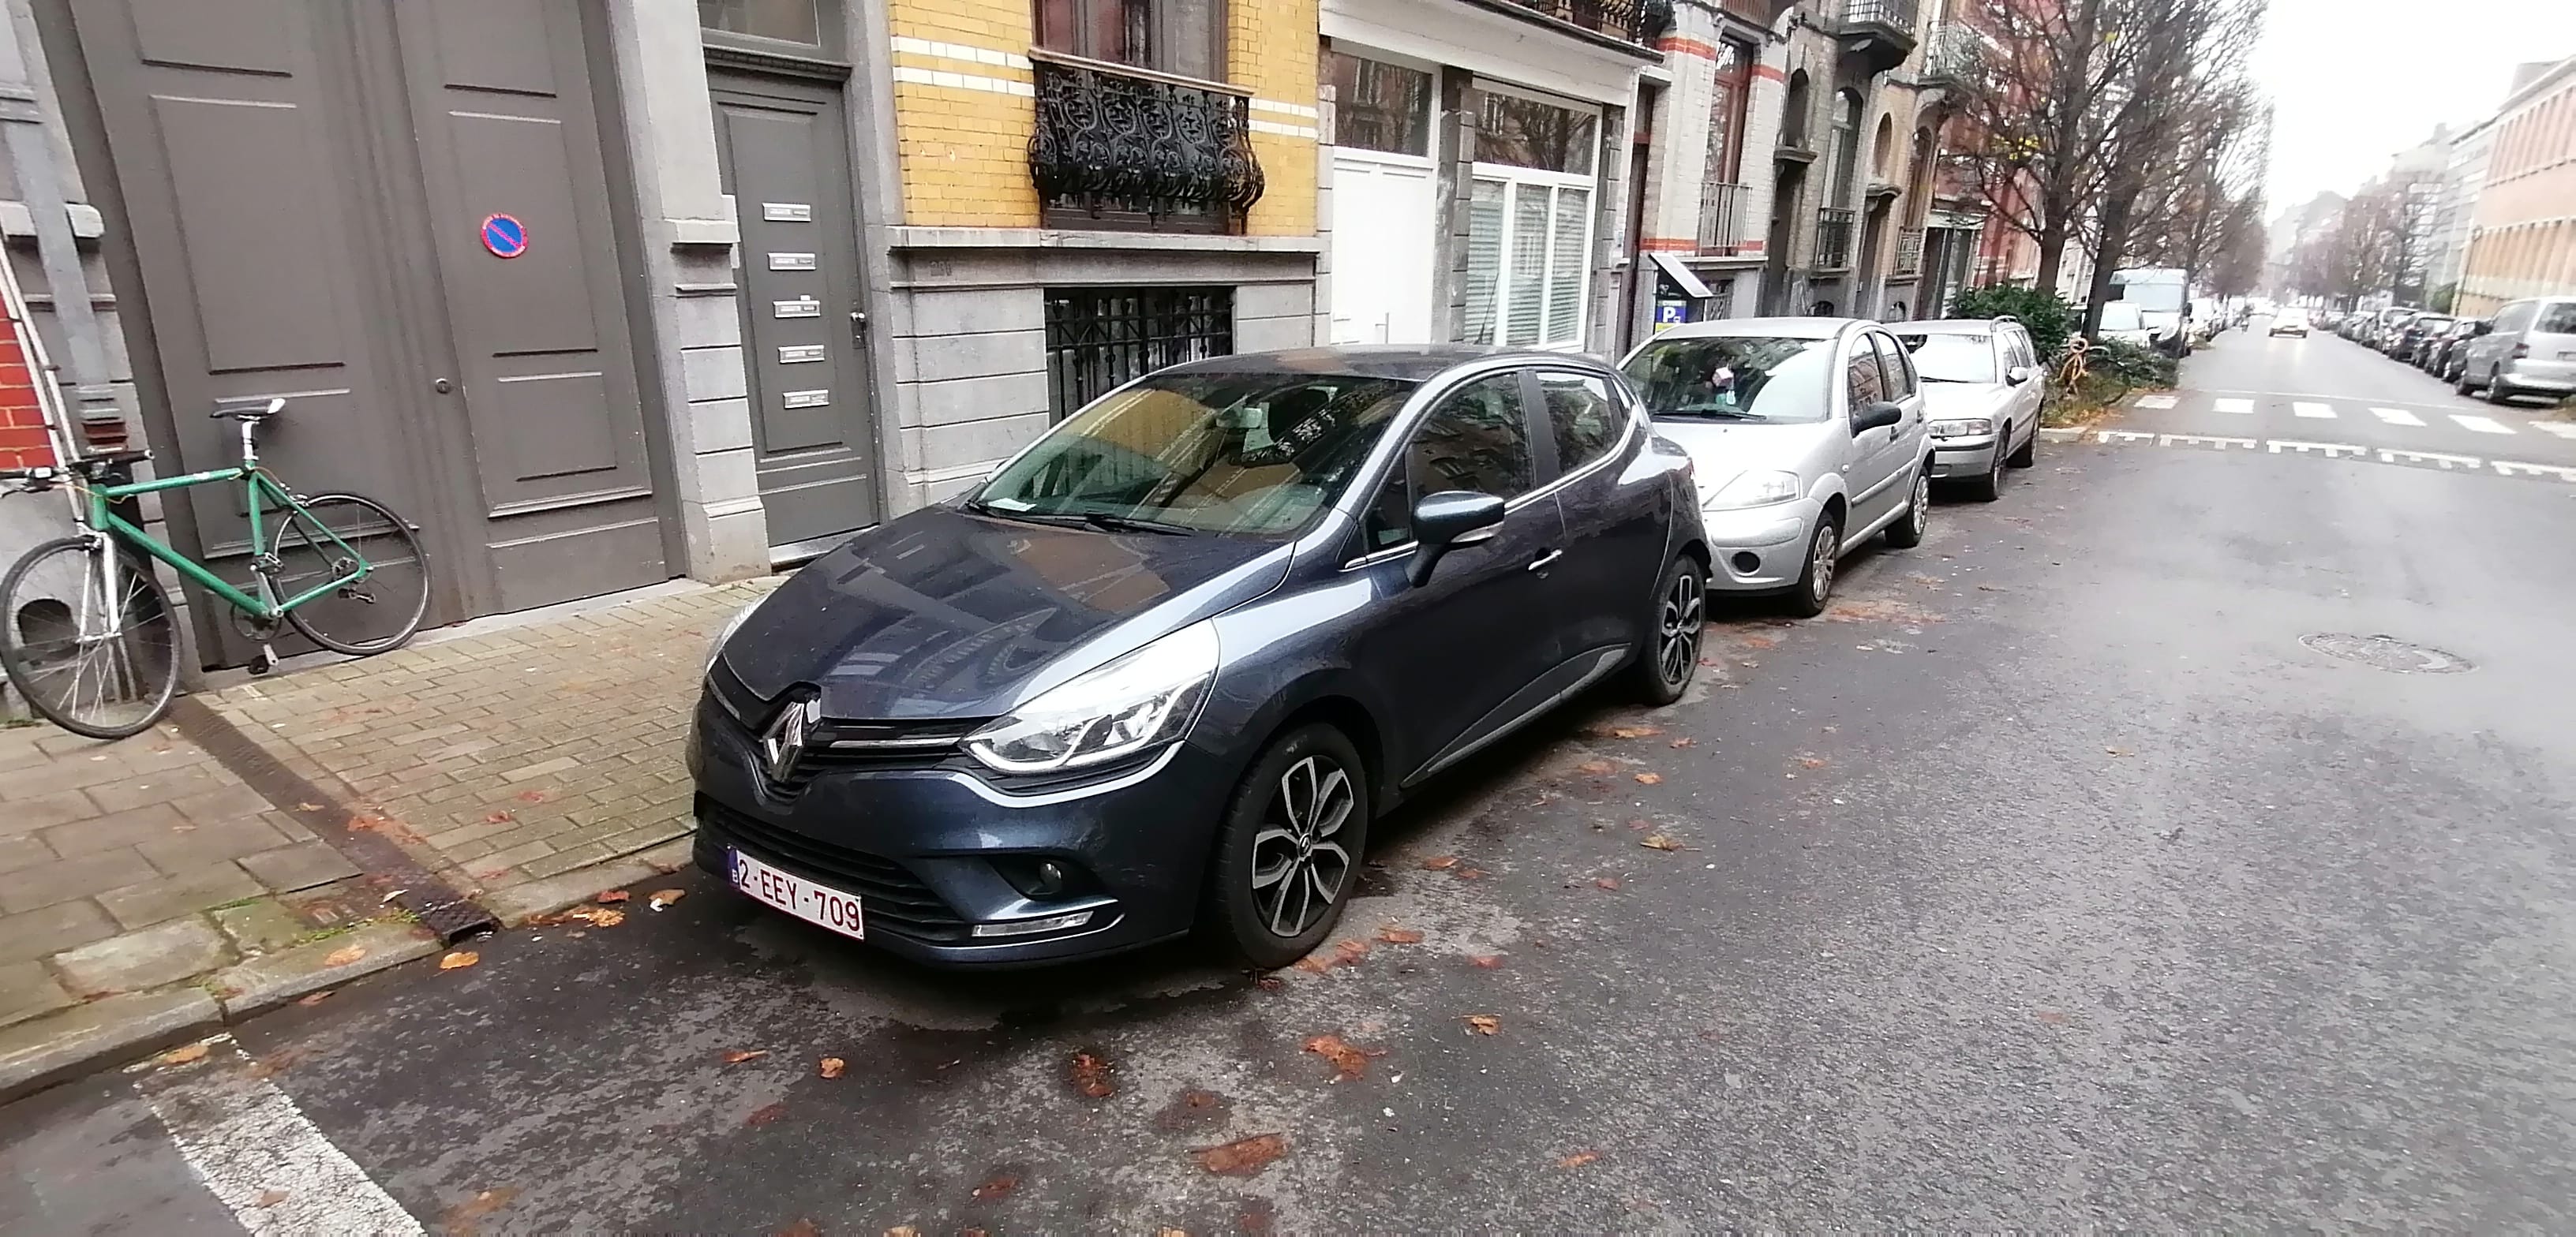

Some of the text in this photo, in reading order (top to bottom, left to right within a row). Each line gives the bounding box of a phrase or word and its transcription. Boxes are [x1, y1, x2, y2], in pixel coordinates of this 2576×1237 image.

[1662, 306, 1676, 323] P
[732, 858, 860, 932] B 2-EEY-709
